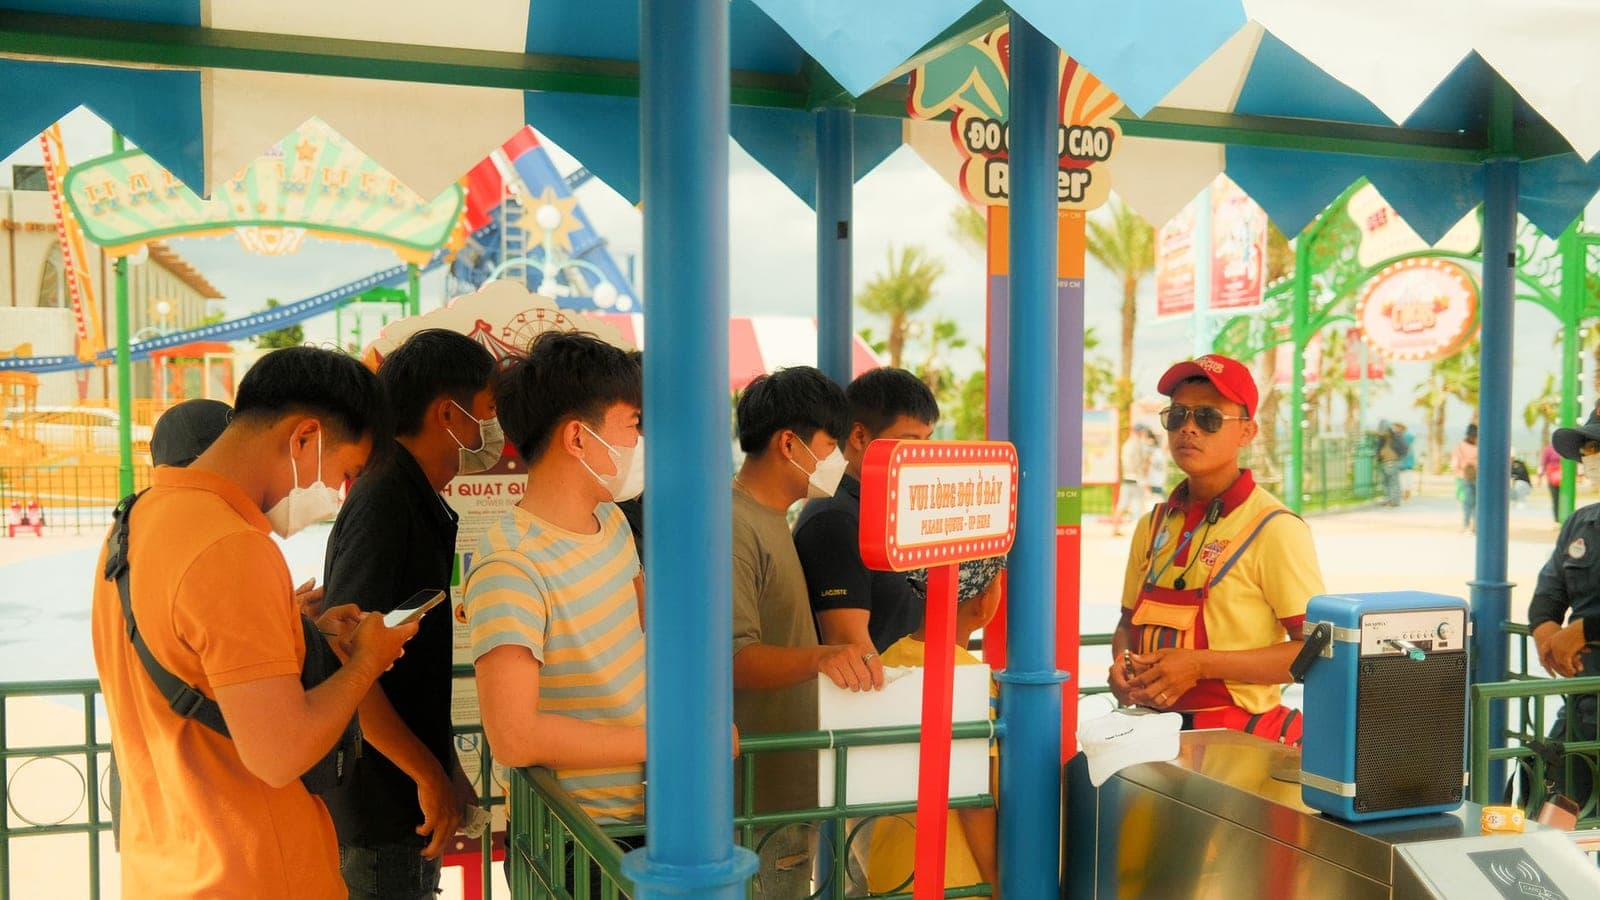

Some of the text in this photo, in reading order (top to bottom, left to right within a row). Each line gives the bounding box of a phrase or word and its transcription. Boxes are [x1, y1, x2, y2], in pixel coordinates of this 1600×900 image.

[967, 121, 1000, 151] ĐO
[1067, 128, 1109, 158] CAO
[987, 160, 1090, 200] Rer
[908, 484, 929, 511] VUI
[930, 477, 956, 509] LÒNG
